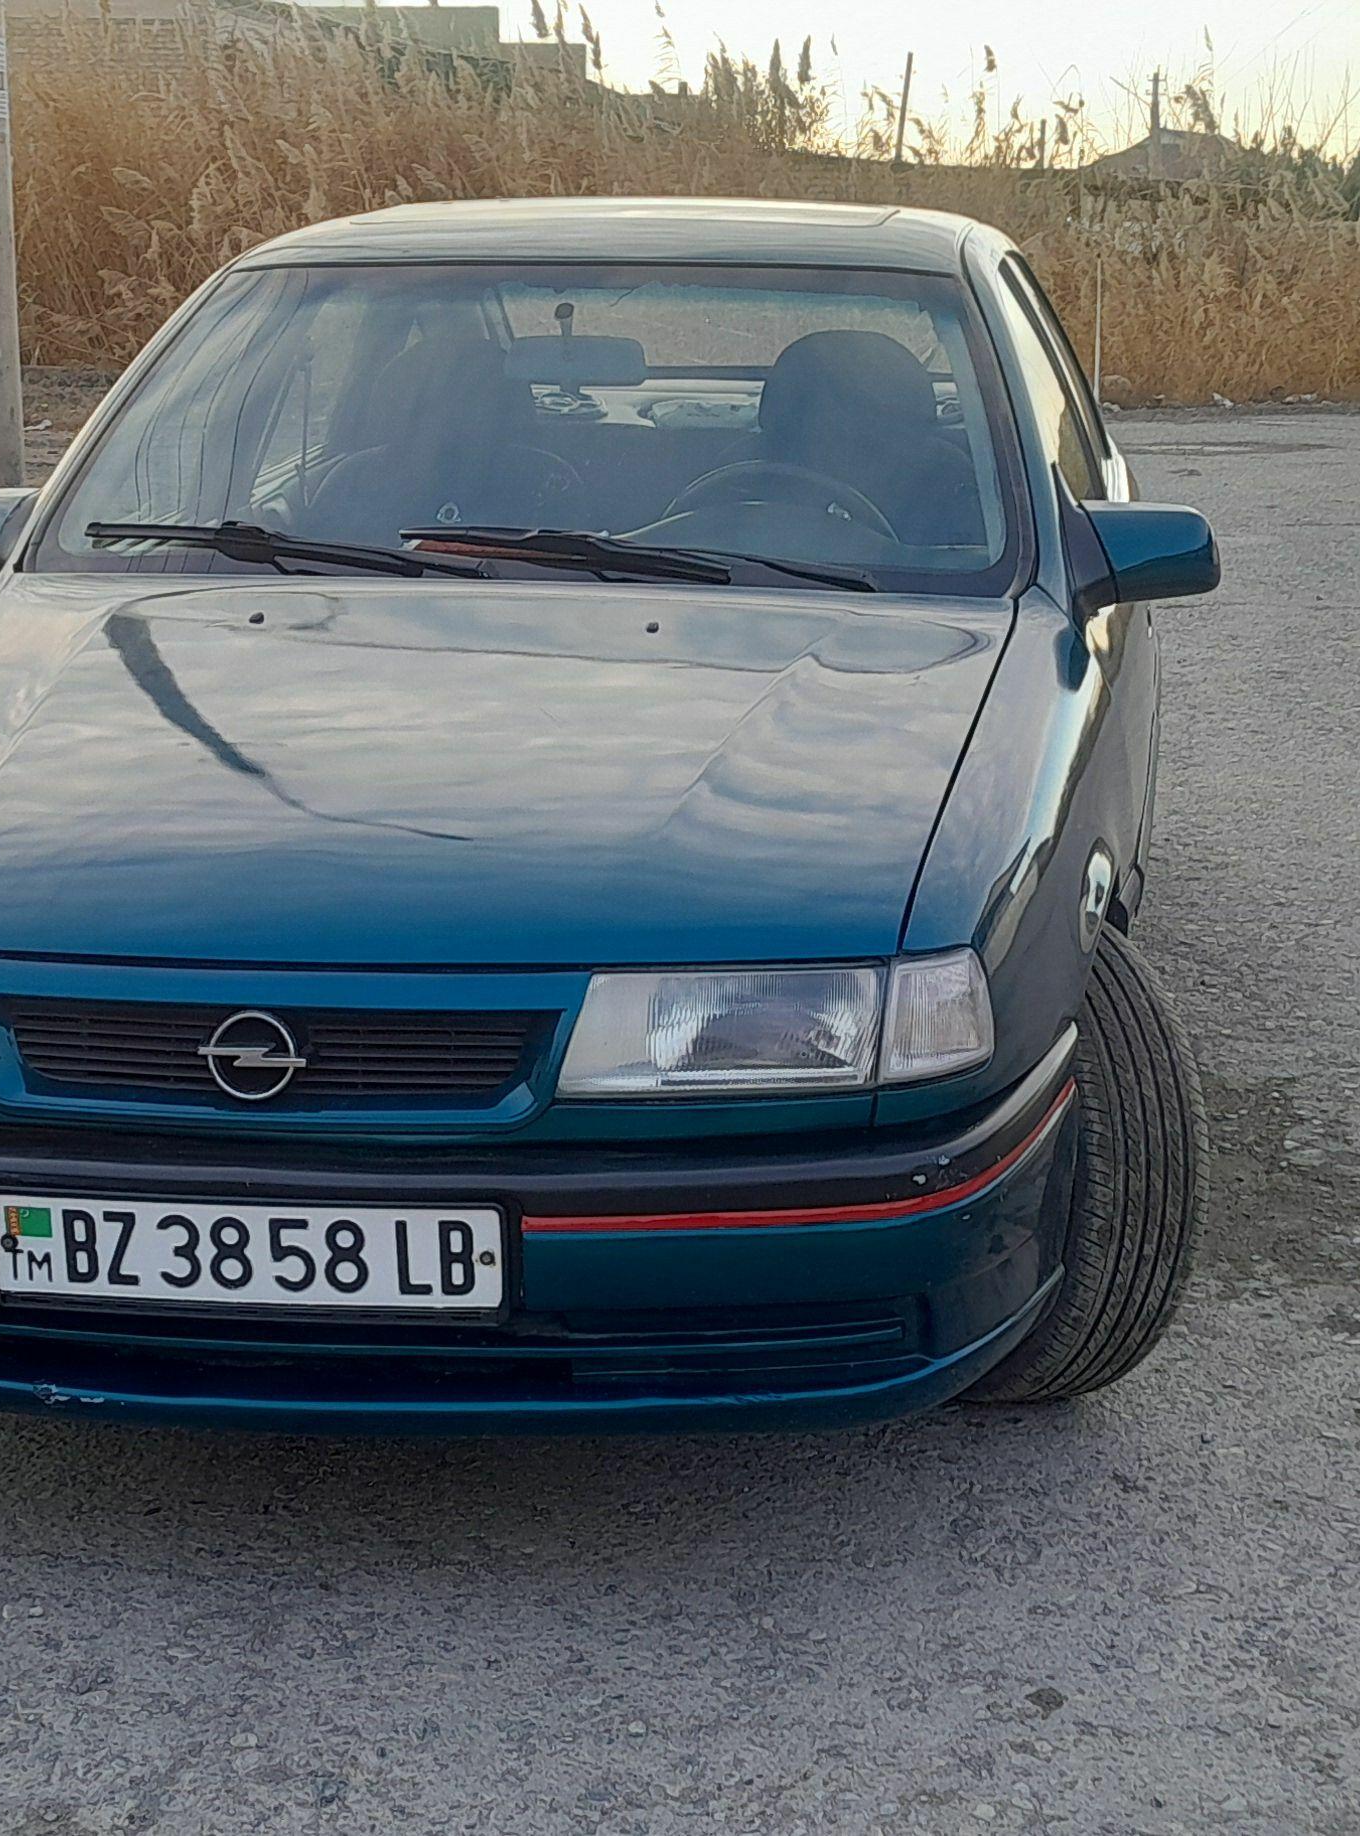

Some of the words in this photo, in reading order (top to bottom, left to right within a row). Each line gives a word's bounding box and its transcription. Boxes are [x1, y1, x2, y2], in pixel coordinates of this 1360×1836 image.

[4, 1248, 53, 1283] TM
[62, 1208, 140, 1286] BZ
[395, 1220, 476, 1296] LB
